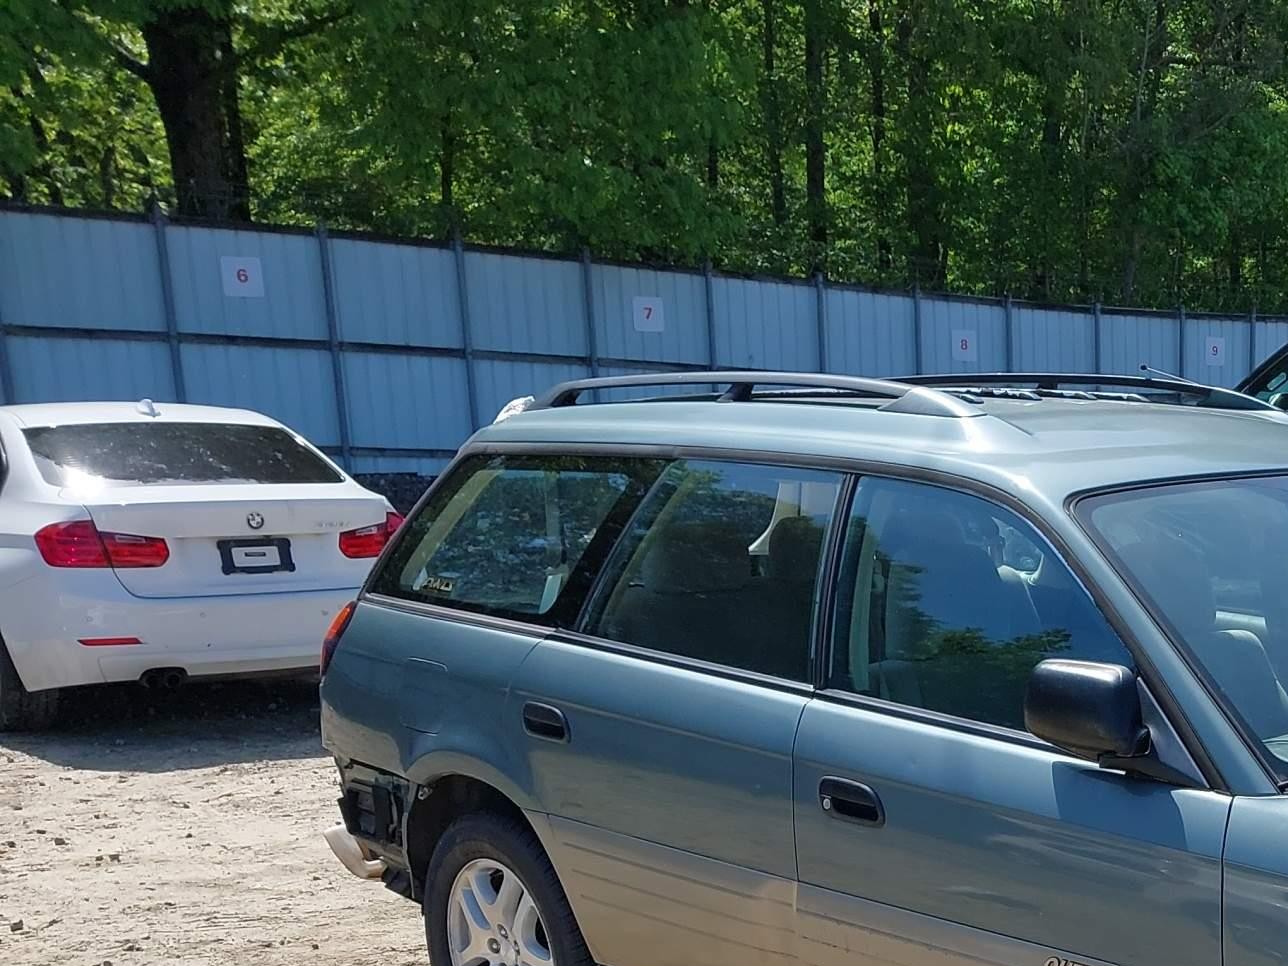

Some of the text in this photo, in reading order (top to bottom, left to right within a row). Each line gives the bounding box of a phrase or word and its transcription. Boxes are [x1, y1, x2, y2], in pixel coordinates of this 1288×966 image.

[236, 268, 249, 284] 6
[643, 307, 652, 320] 7
[960, 339, 968, 350] 8
[1211, 345, 1218, 356] 9
